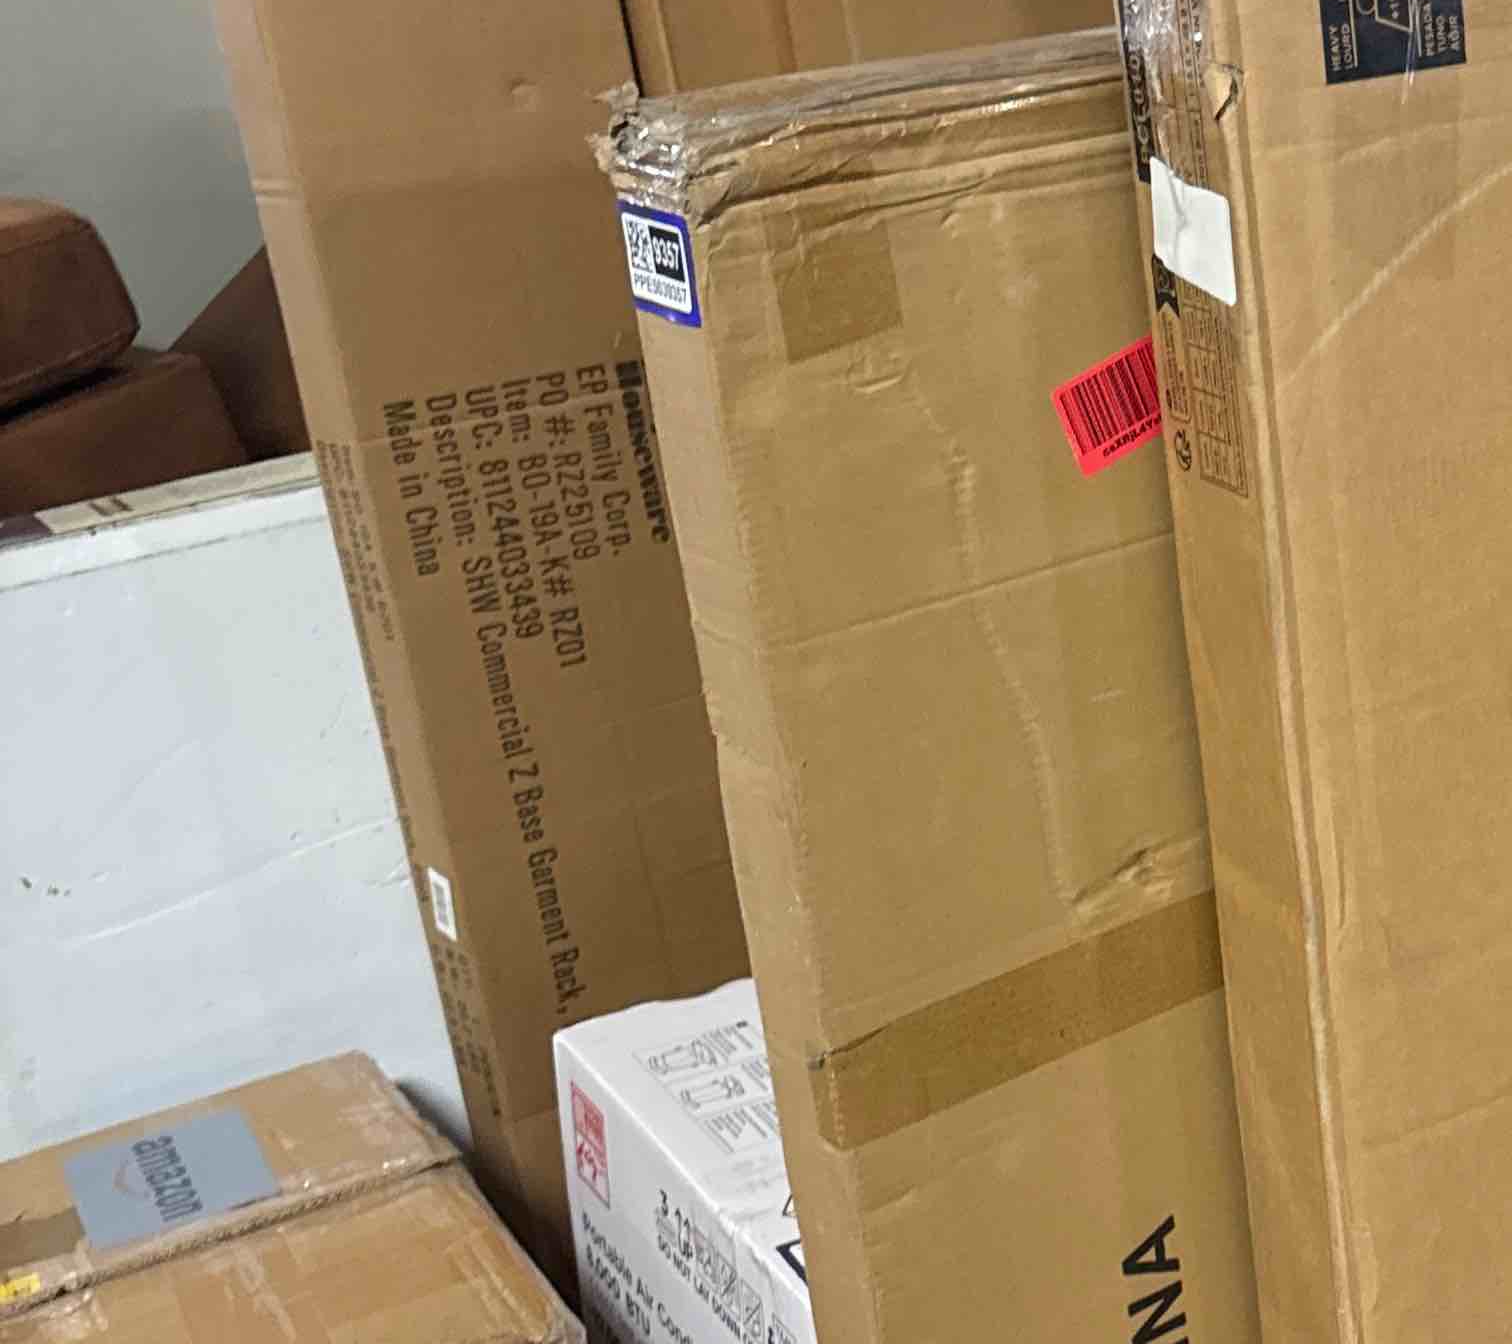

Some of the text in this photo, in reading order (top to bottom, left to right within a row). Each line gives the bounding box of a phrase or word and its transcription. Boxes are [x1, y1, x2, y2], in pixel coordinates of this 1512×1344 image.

[502, 377, 531, 444] Item:
[575, 363, 633, 557] EP Family Corp.
[383, 399, 445, 578] Made in China
[425, 392, 476, 548] Description:
[465, 385, 546, 640] UPC: 811244033439
[462, 556, 503, 614] SHW
[476, 622, 535, 759] Commercial
[513, 785, 546, 844] Base
[527, 847, 571, 946] Garment
[132, 1134, 204, 1223] amazon
[625, 1291, 651, 1337] BTU
